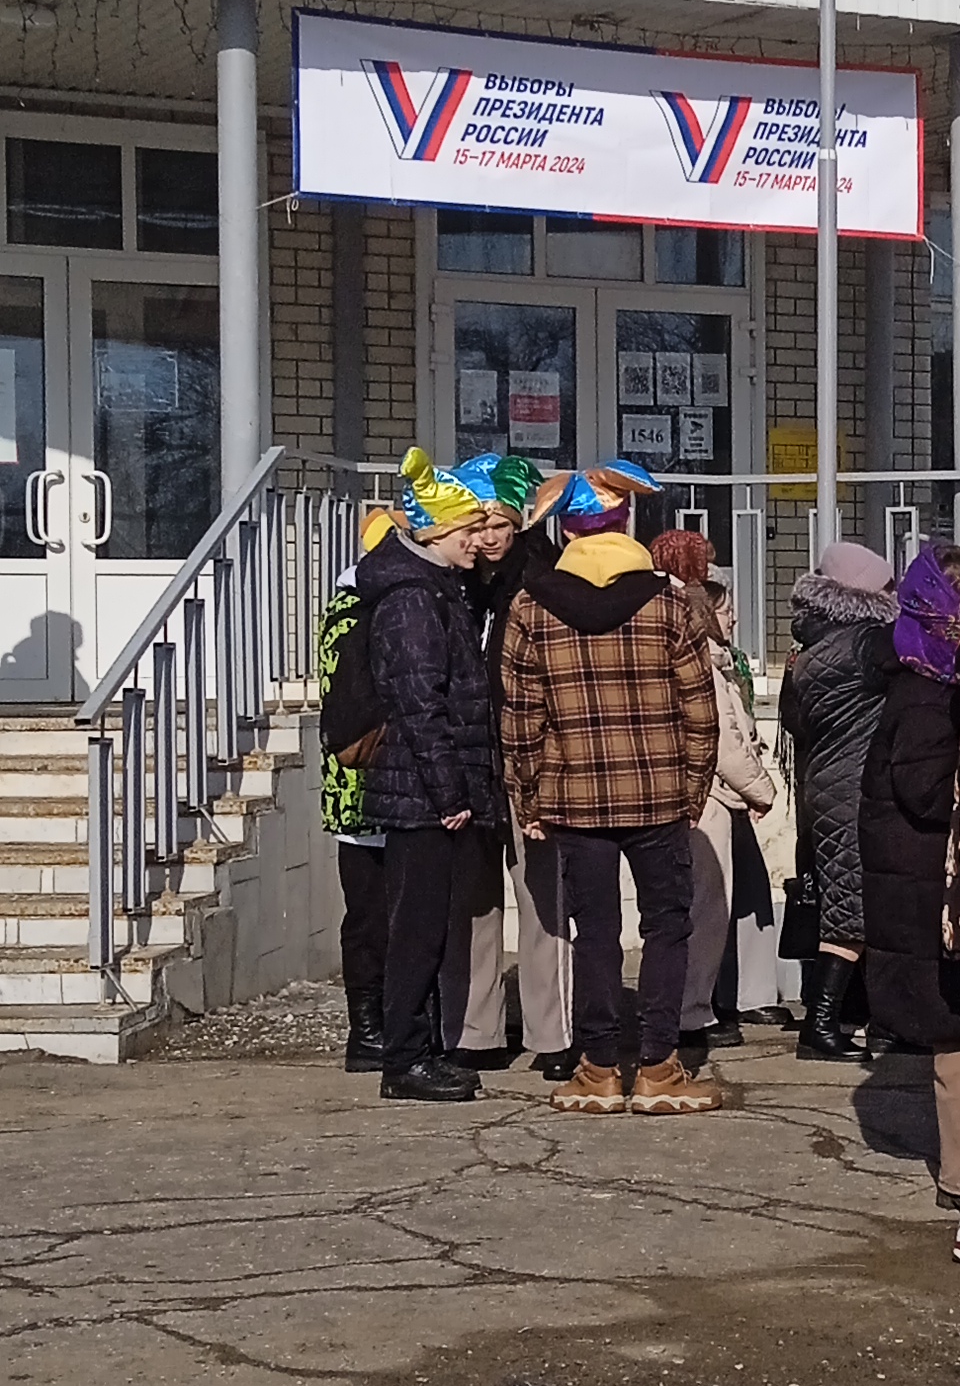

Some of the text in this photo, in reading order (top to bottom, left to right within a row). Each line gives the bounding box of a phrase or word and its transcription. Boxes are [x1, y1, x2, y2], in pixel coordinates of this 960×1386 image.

[484, 73, 574, 97] ВЫБОРЫ
[472, 97, 605, 126] ПРЕЗИДЕНТА
[763, 98, 846, 122] ВЫБО
[461, 123, 549, 148] РОССИИ
[753, 121, 868, 148] ПРЕЗИДНТА
[453, 148, 586, 174] 15–17 МАРТА 2024
[742, 146, 816, 170] РОССИИ
[733, 170, 771, 189] 15–17
[770, 174, 817, 192] МАРТА
[630, 428, 664, 444] 1546
